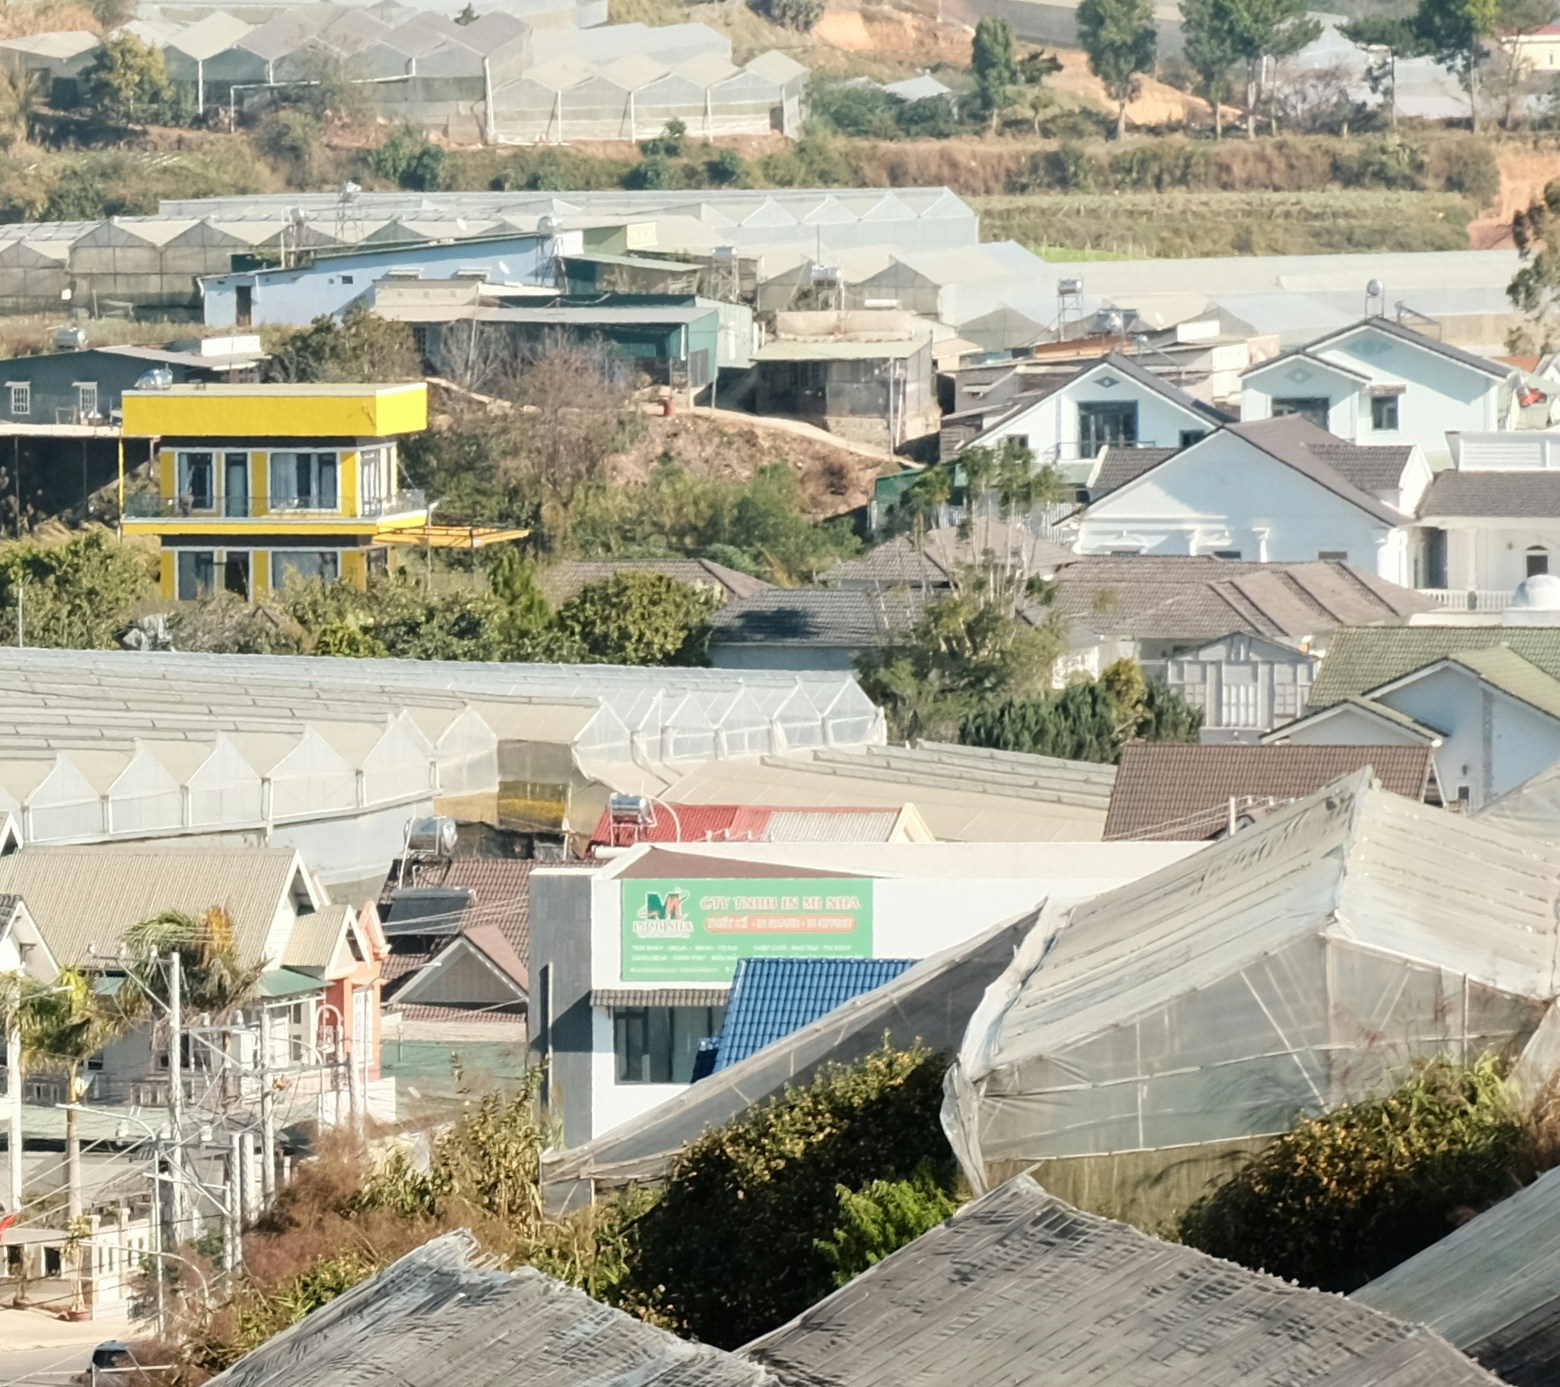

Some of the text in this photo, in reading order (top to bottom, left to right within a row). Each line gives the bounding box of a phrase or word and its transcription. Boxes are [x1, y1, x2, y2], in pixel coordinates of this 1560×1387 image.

[700, 896, 862, 910] CTY TNHH IN MI NHA
